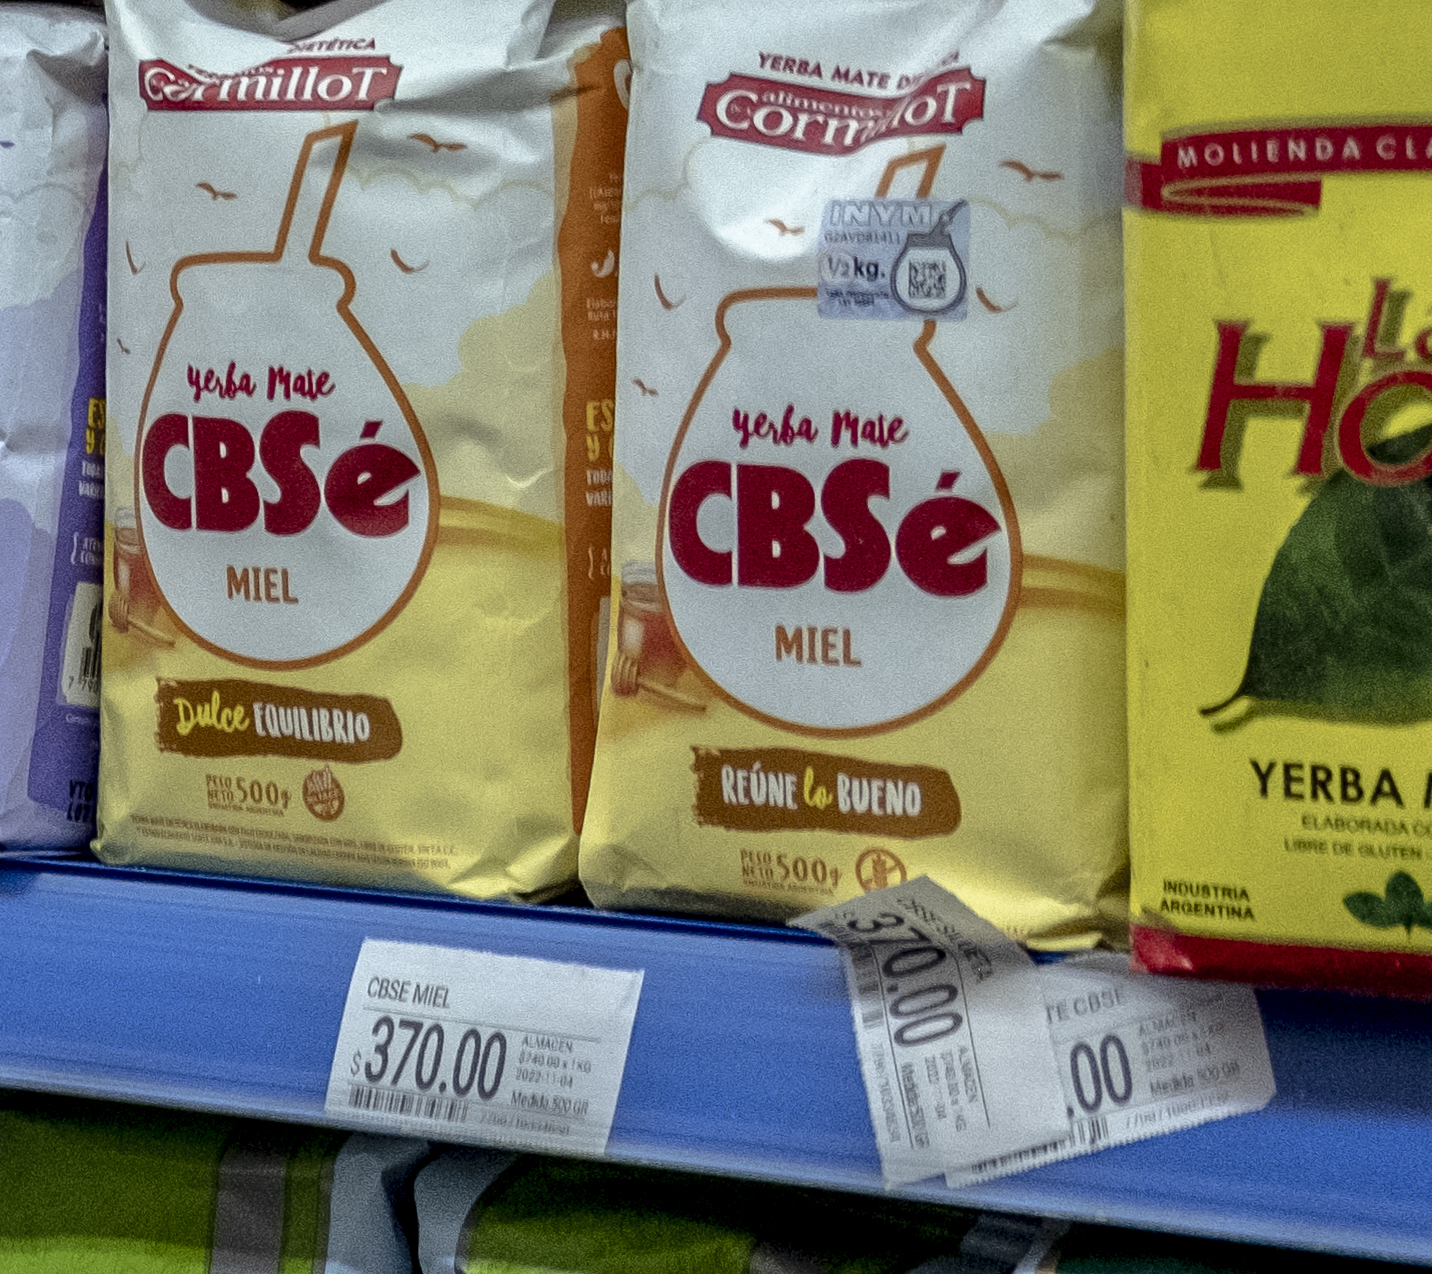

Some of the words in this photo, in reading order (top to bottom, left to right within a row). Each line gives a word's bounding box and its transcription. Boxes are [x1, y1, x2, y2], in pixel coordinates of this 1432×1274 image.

[1177, 136, 1360, 169] MOLIENDA
[142, 410, 421, 537] CBSé
[668, 459, 1002, 597] CBSé
[226, 567, 298, 604] MIEL
[773, 625, 863, 667] MIEL
[254, 699, 371, 742] EQUILIBRIO
[367, 975, 409, 1004] CBSE
[412, 982, 450, 1009] MIEL
